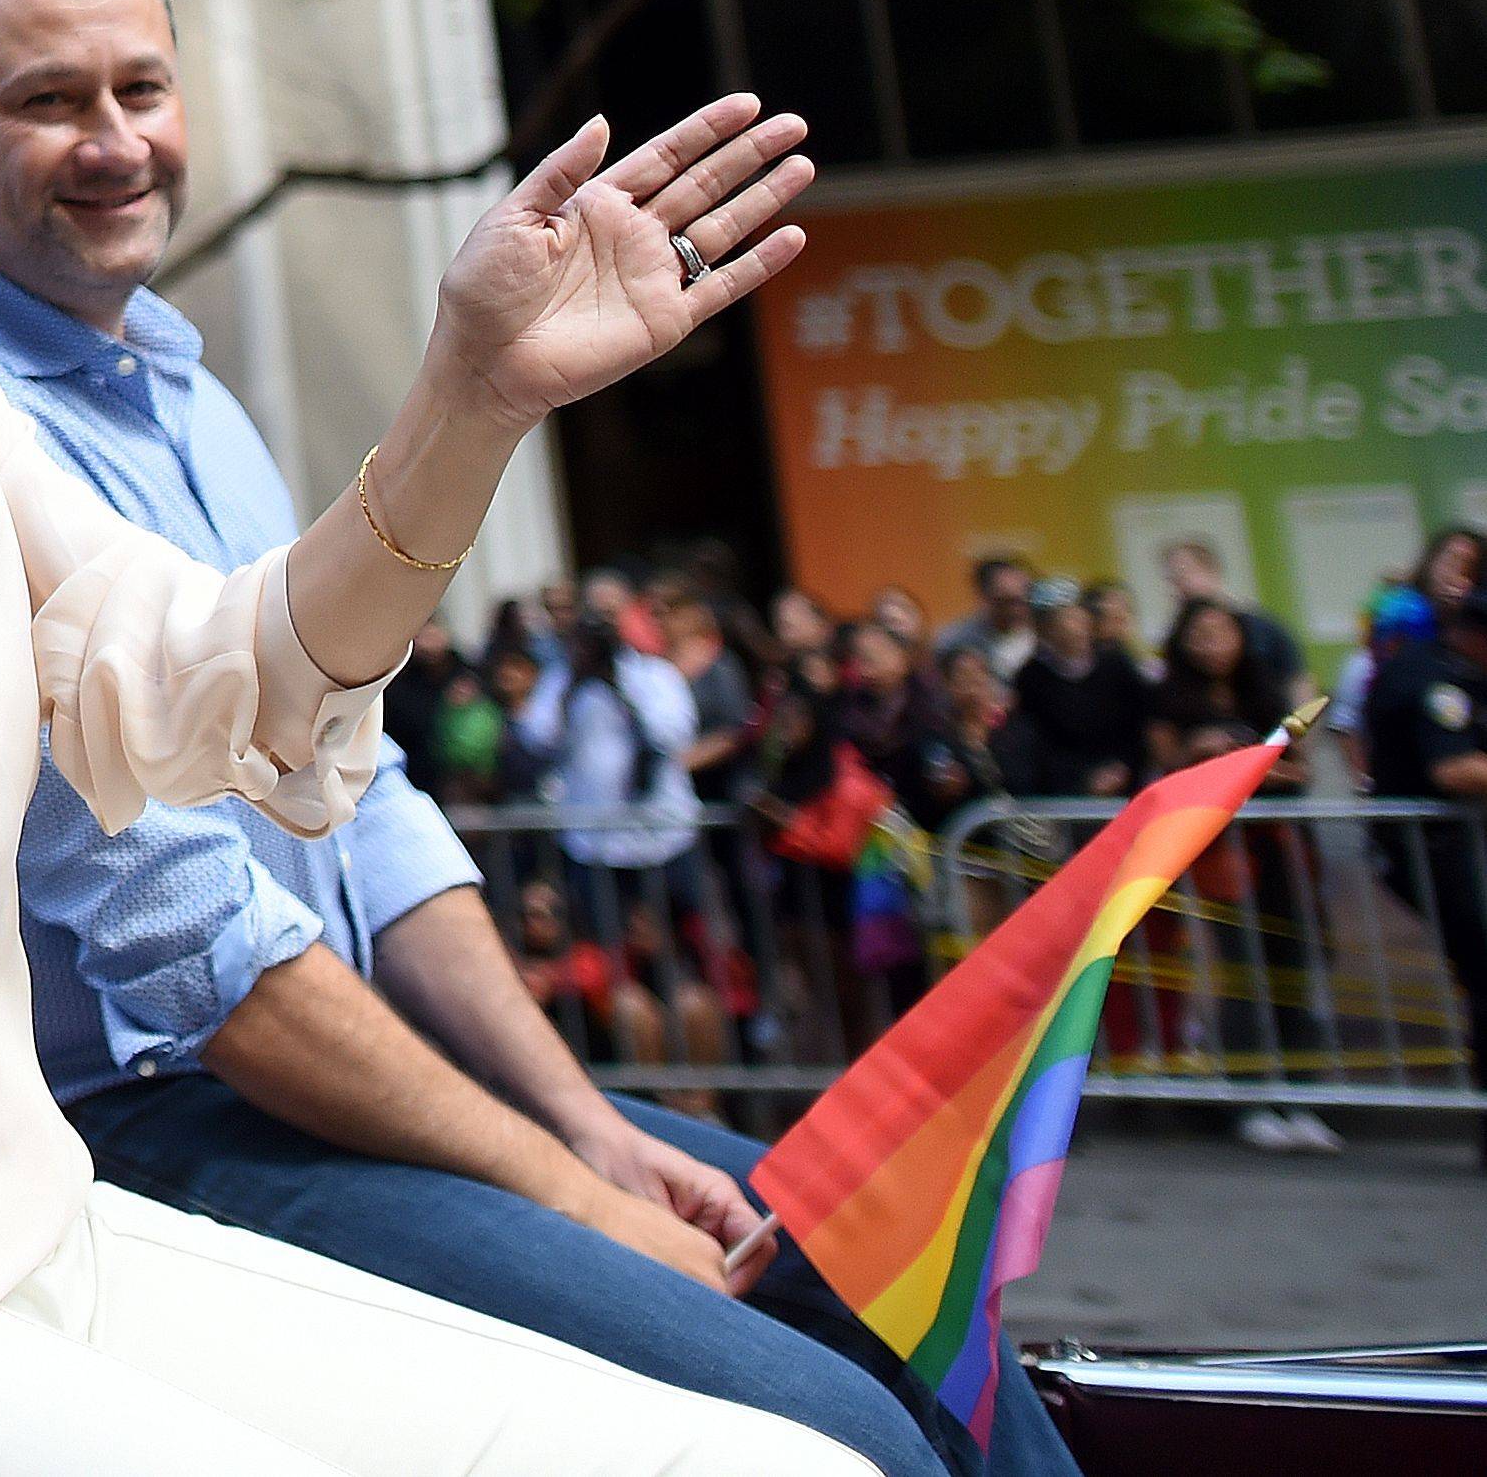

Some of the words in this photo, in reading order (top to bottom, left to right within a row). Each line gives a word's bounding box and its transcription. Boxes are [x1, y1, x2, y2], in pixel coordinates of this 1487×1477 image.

[796, 226, 1487, 354] #TOGETHER
[814, 386, 1100, 481] Happy
[1117, 355, 1363, 451] Pride
